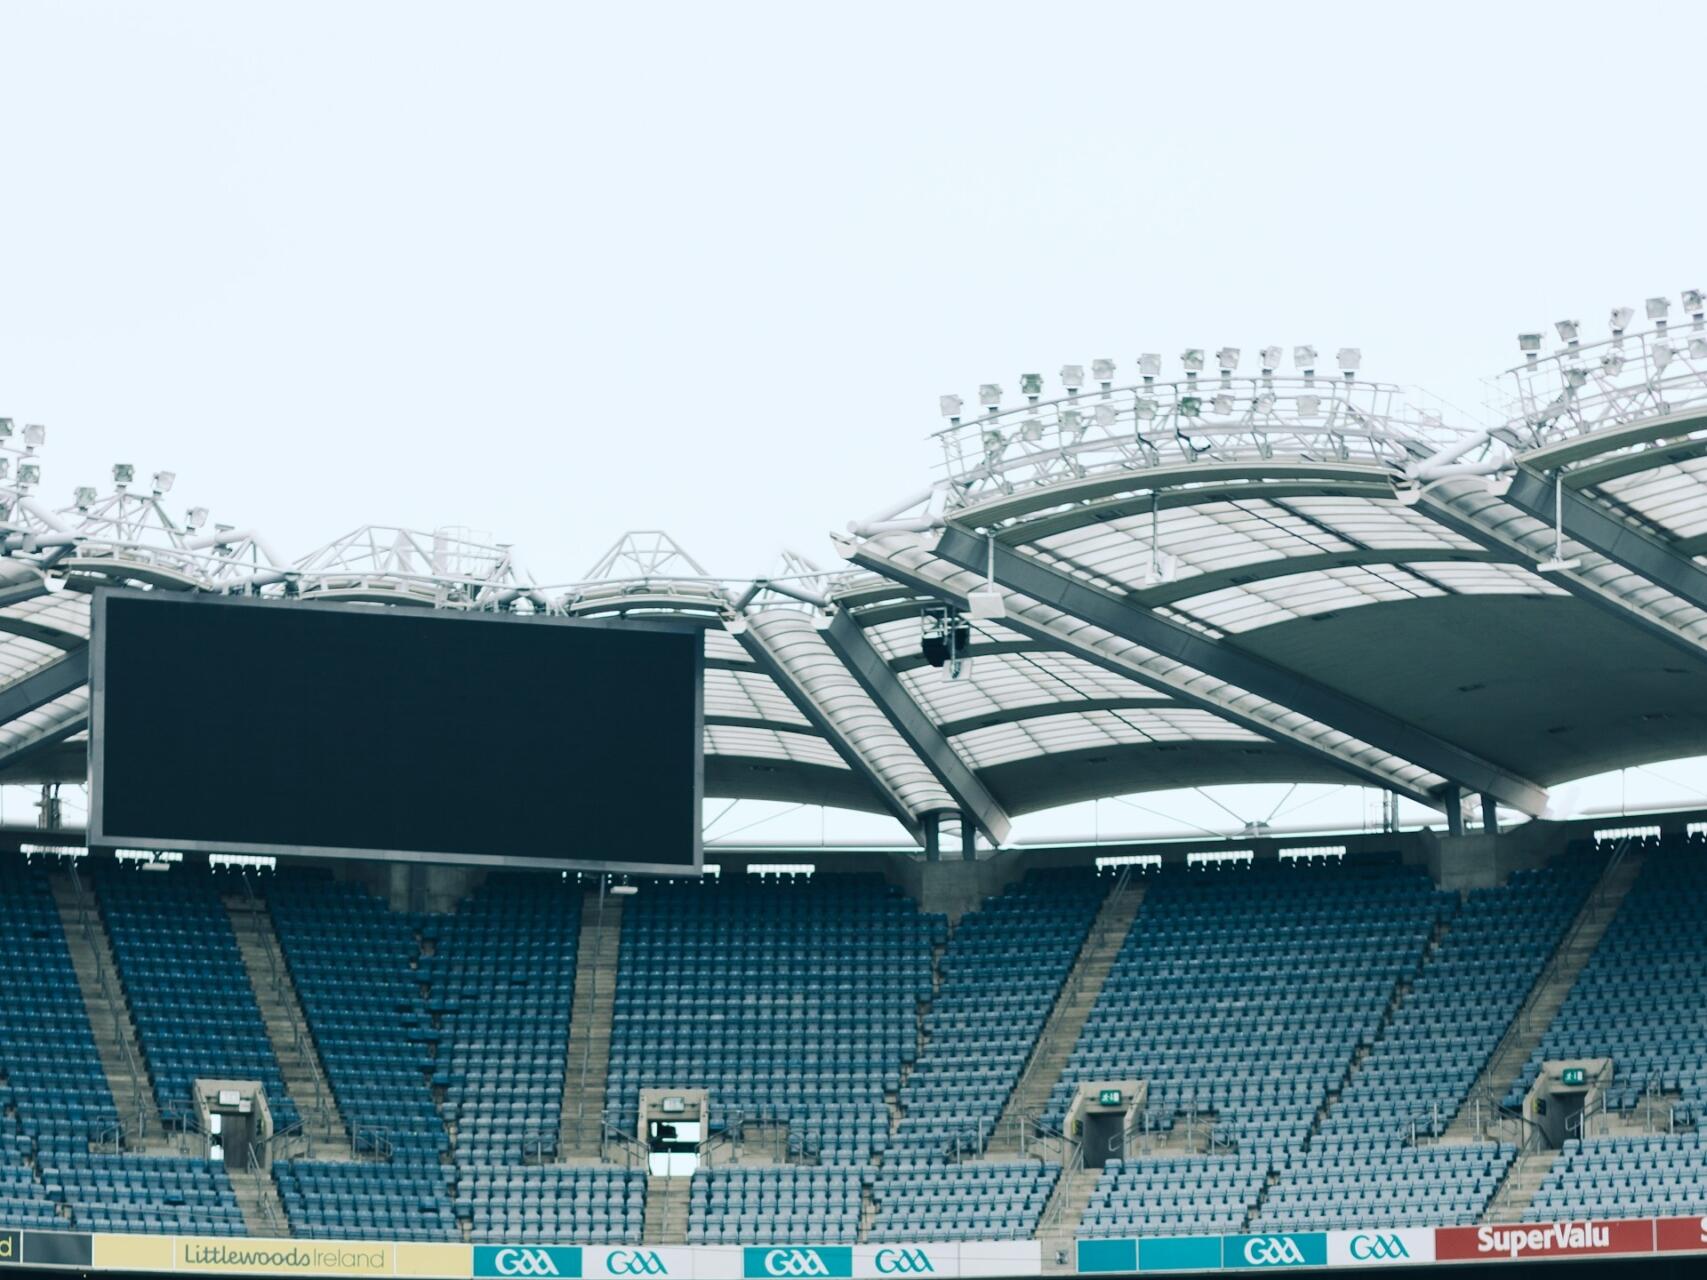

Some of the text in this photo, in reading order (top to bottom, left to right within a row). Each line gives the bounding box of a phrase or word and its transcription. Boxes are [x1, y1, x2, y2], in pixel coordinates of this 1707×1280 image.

[1477, 1222, 1609, 1257] SuperValu
[185, 1244, 385, 1268] Littlewoods Ireland
